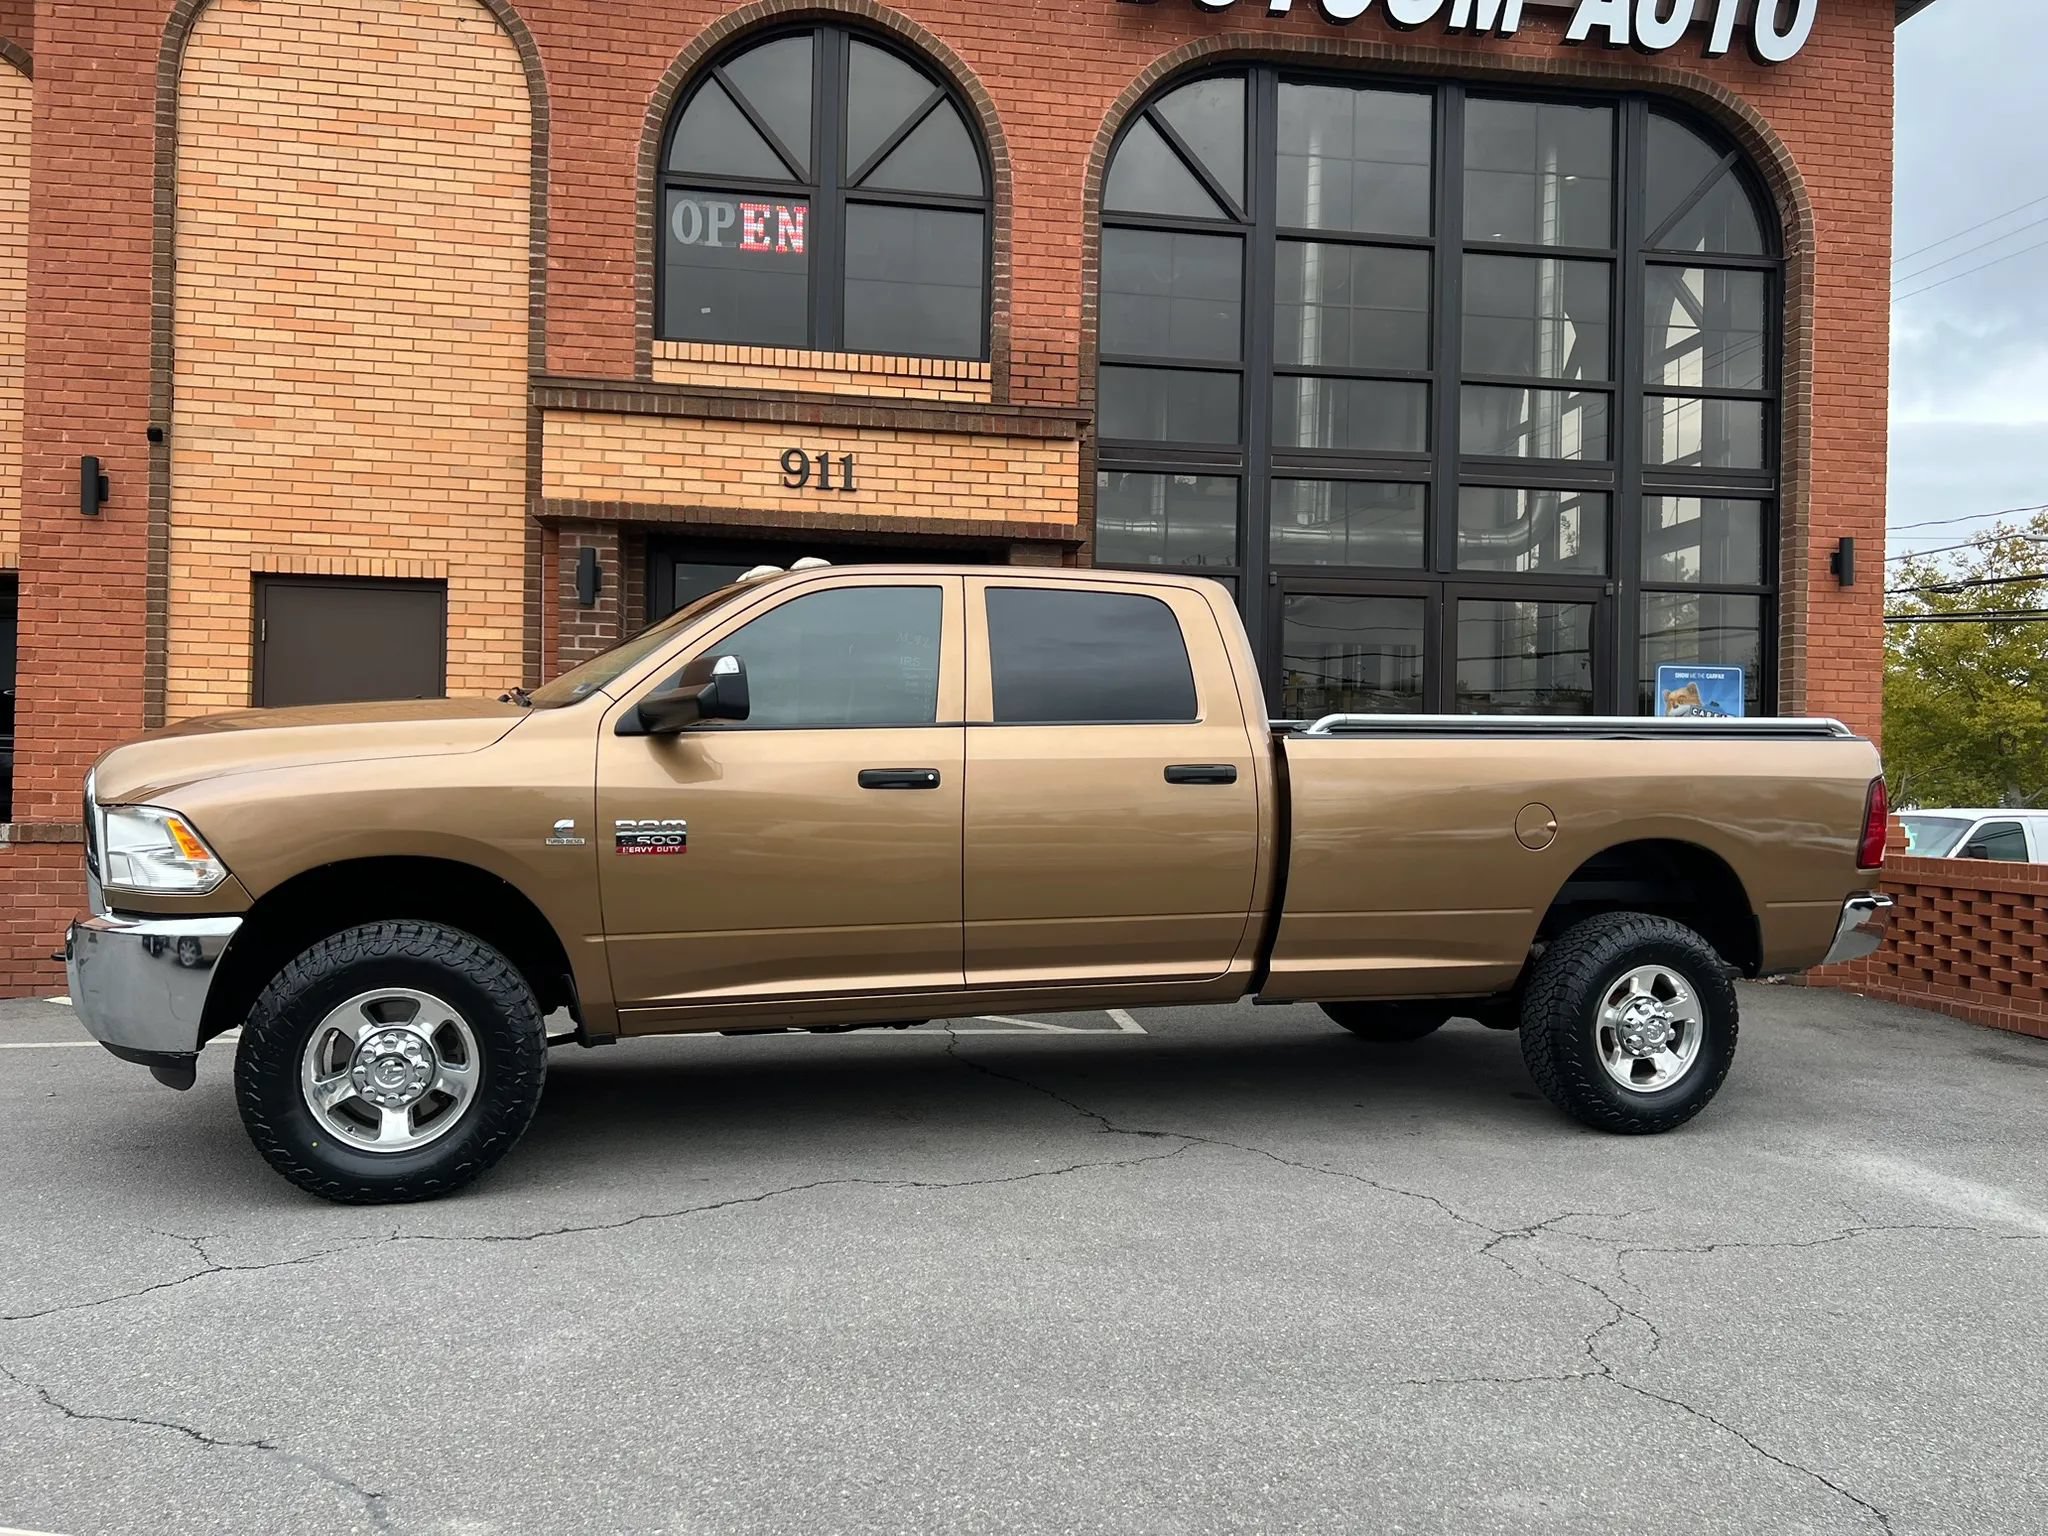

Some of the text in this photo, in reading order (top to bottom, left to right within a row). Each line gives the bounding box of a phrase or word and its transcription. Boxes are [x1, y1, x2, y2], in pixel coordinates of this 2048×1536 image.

[672, 199, 808, 253] OPEN
[780, 447, 857, 491] 911
[1692, 708, 1727, 717] CARF
